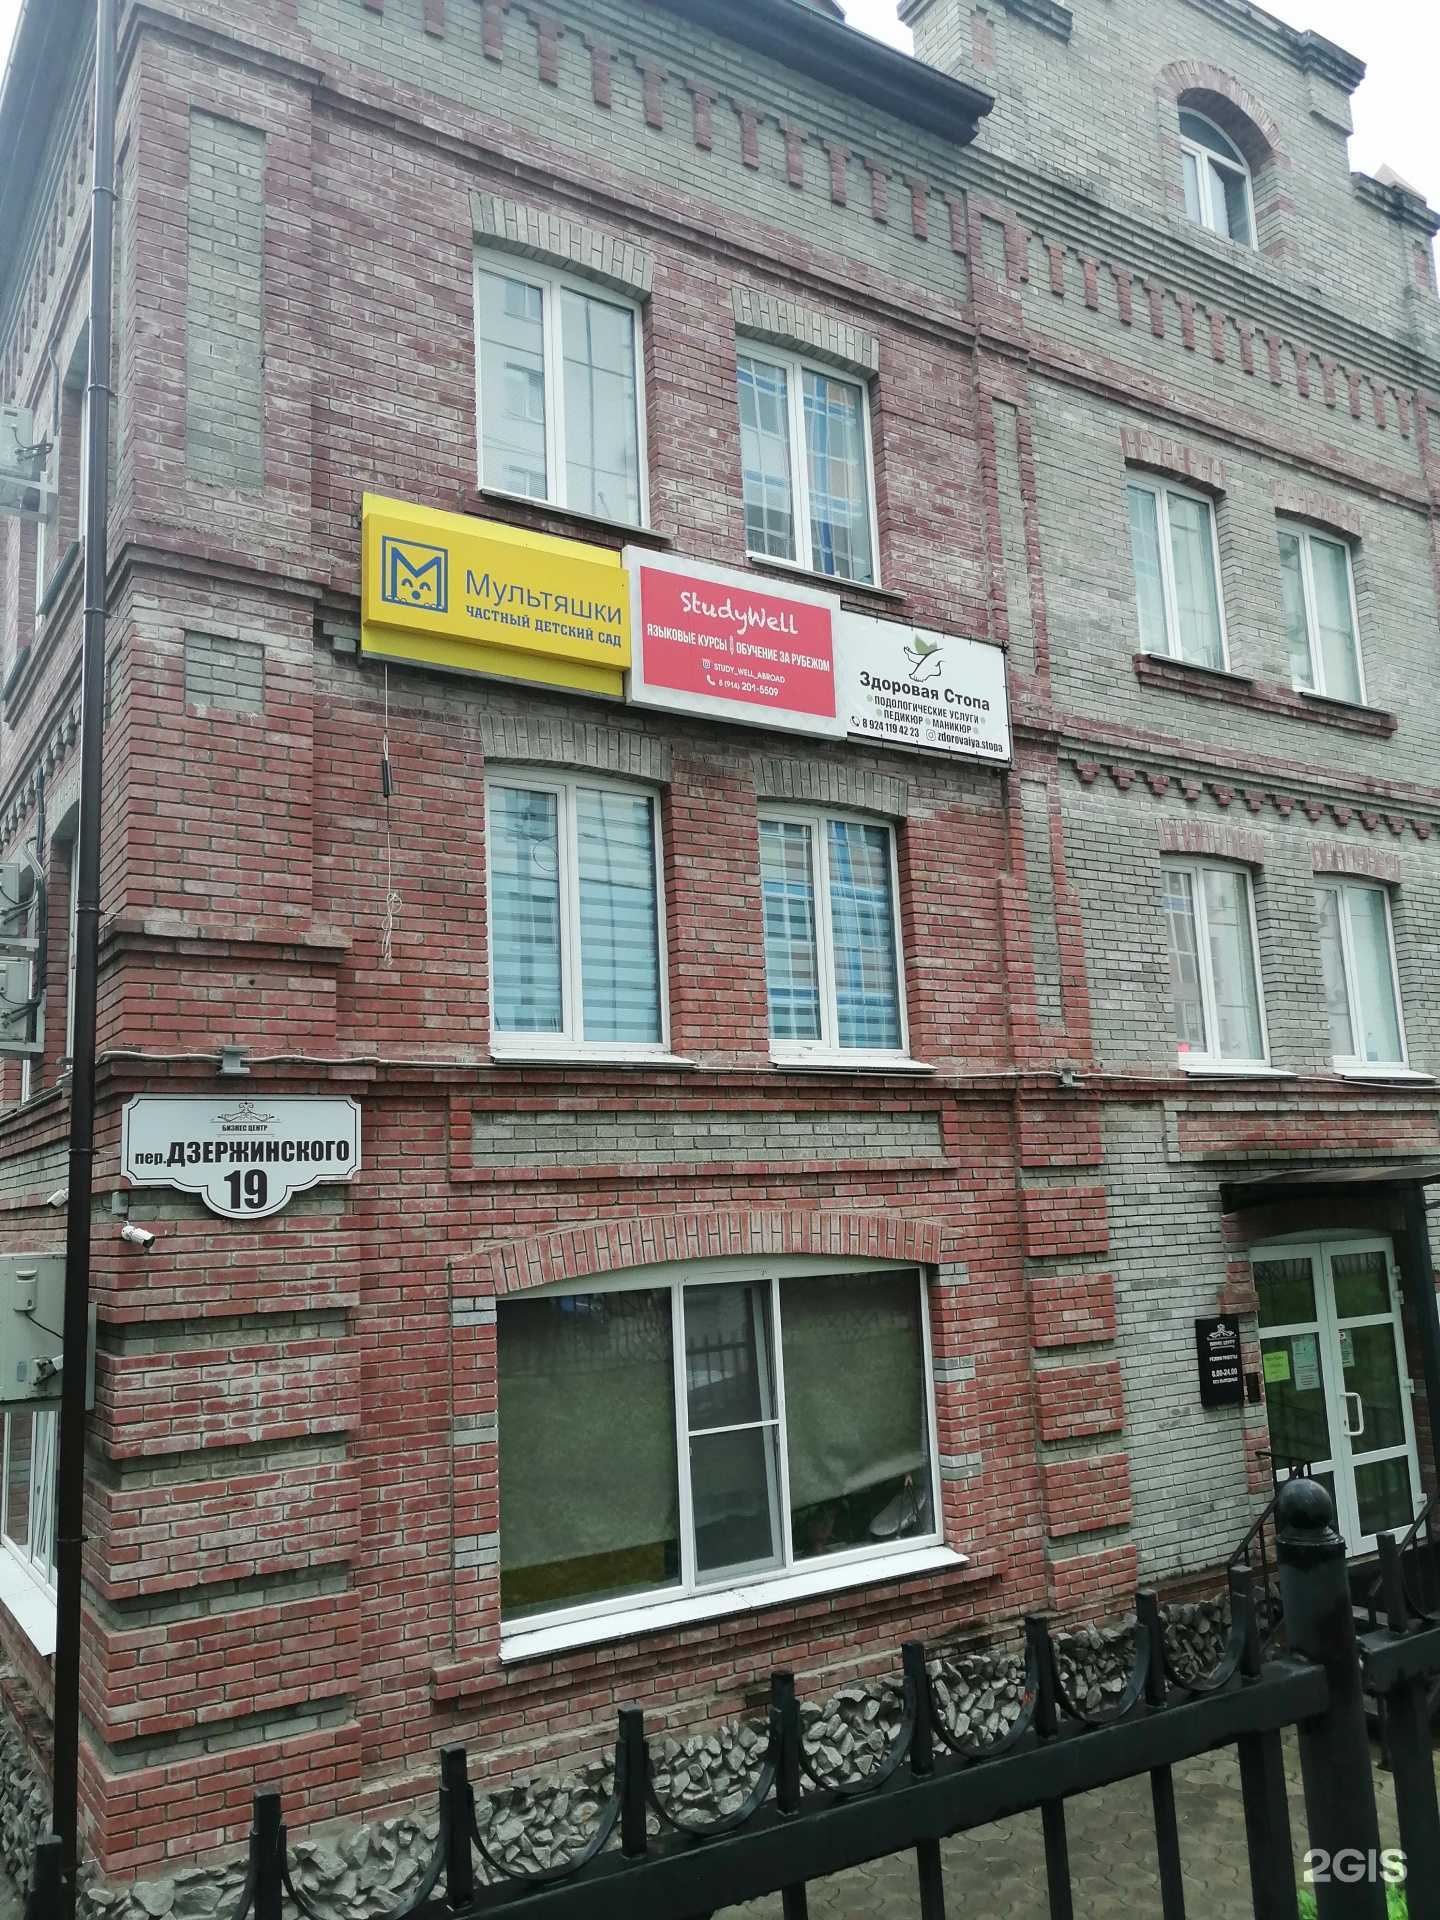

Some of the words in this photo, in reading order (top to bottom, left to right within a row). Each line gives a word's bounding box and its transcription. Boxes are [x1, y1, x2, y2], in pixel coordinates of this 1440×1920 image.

[465, 569, 622, 625] Мультяшки
[680, 591, 799, 635] StudyWell
[466, 605, 531, 629] ЧАСТНЫЙ
[535, 619, 594, 641] ДЕТСКИЙ
[598, 632, 622, 648] САД
[647, 623, 696, 645] ЯЗЫКОВЫЕ
[698, 633, 727, 651] КУРСЫ
[736, 642, 778, 662] ОБУЧЕНИЕ
[779, 651, 791, 664] ЗА
[791, 654, 830, 672] РУБЕЖОМ
[713, 663, 785, 684] STUDY_WELL_ABROAD
[741, 682, 779, 696] 201-5509
[859, 671, 939, 700] Здоровая
[943, 688, 990, 711] Стопа
[874, 695, 948, 717] ПОДОЛОГИЧЕСКИЕ
[949, 710, 979, 724] УСЛУГИ
[884, 709, 924, 725] ПЕДИКЮР
[932, 718, 972, 734] МАНИКЮР
[862, 718, 868, 728] 8
[869, 718, 884, 731] 924
[885, 722, 898, 734] 119
[899, 725, 909, 735] 42
[909, 727, 920, 737] 23
[221, 1124, 247, 1132] БИЗНЕС
[248, 1124, 268, 1132] ЦЕНТР
[223, 1169, 268, 1209] 19
